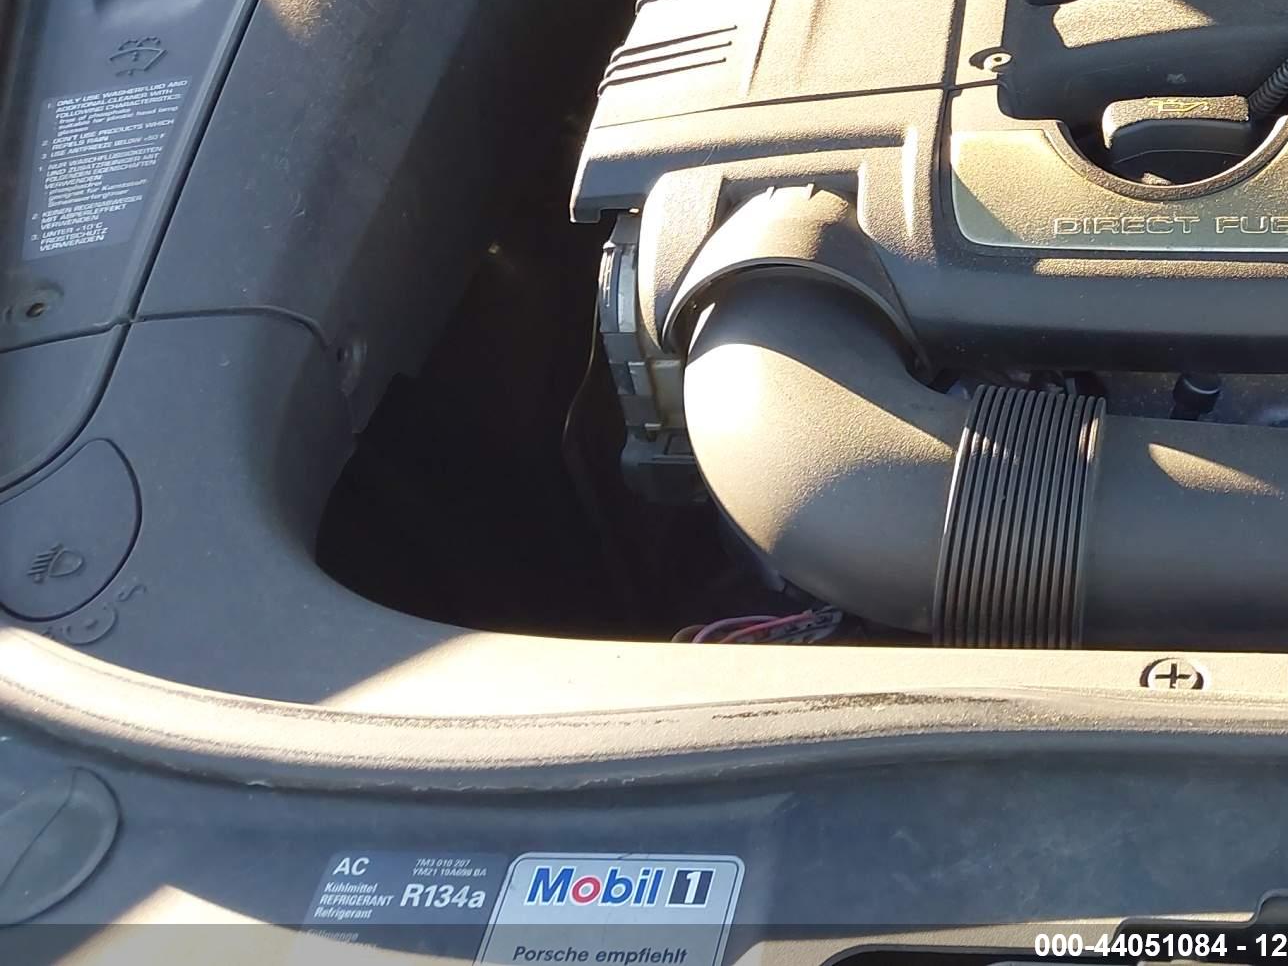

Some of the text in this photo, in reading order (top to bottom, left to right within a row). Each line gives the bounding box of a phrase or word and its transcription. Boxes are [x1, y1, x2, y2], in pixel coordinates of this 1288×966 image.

[57, 98, 82, 106] ONLY
[83, 94, 100, 102] USE
[80, 131, 96, 139] USE
[51, 149, 66, 157] USE
[1053, 215, 1200, 236] DIRECT
[333, 857, 370, 876] AC
[525, 866, 665, 906] Mobil
[320, 894, 394, 907] REFRIGERANT
[400, 884, 486, 908] R134a
[314, 907, 373, 920] Refrigerant
[512, 946, 688, 965] Porsche empfiehlt
